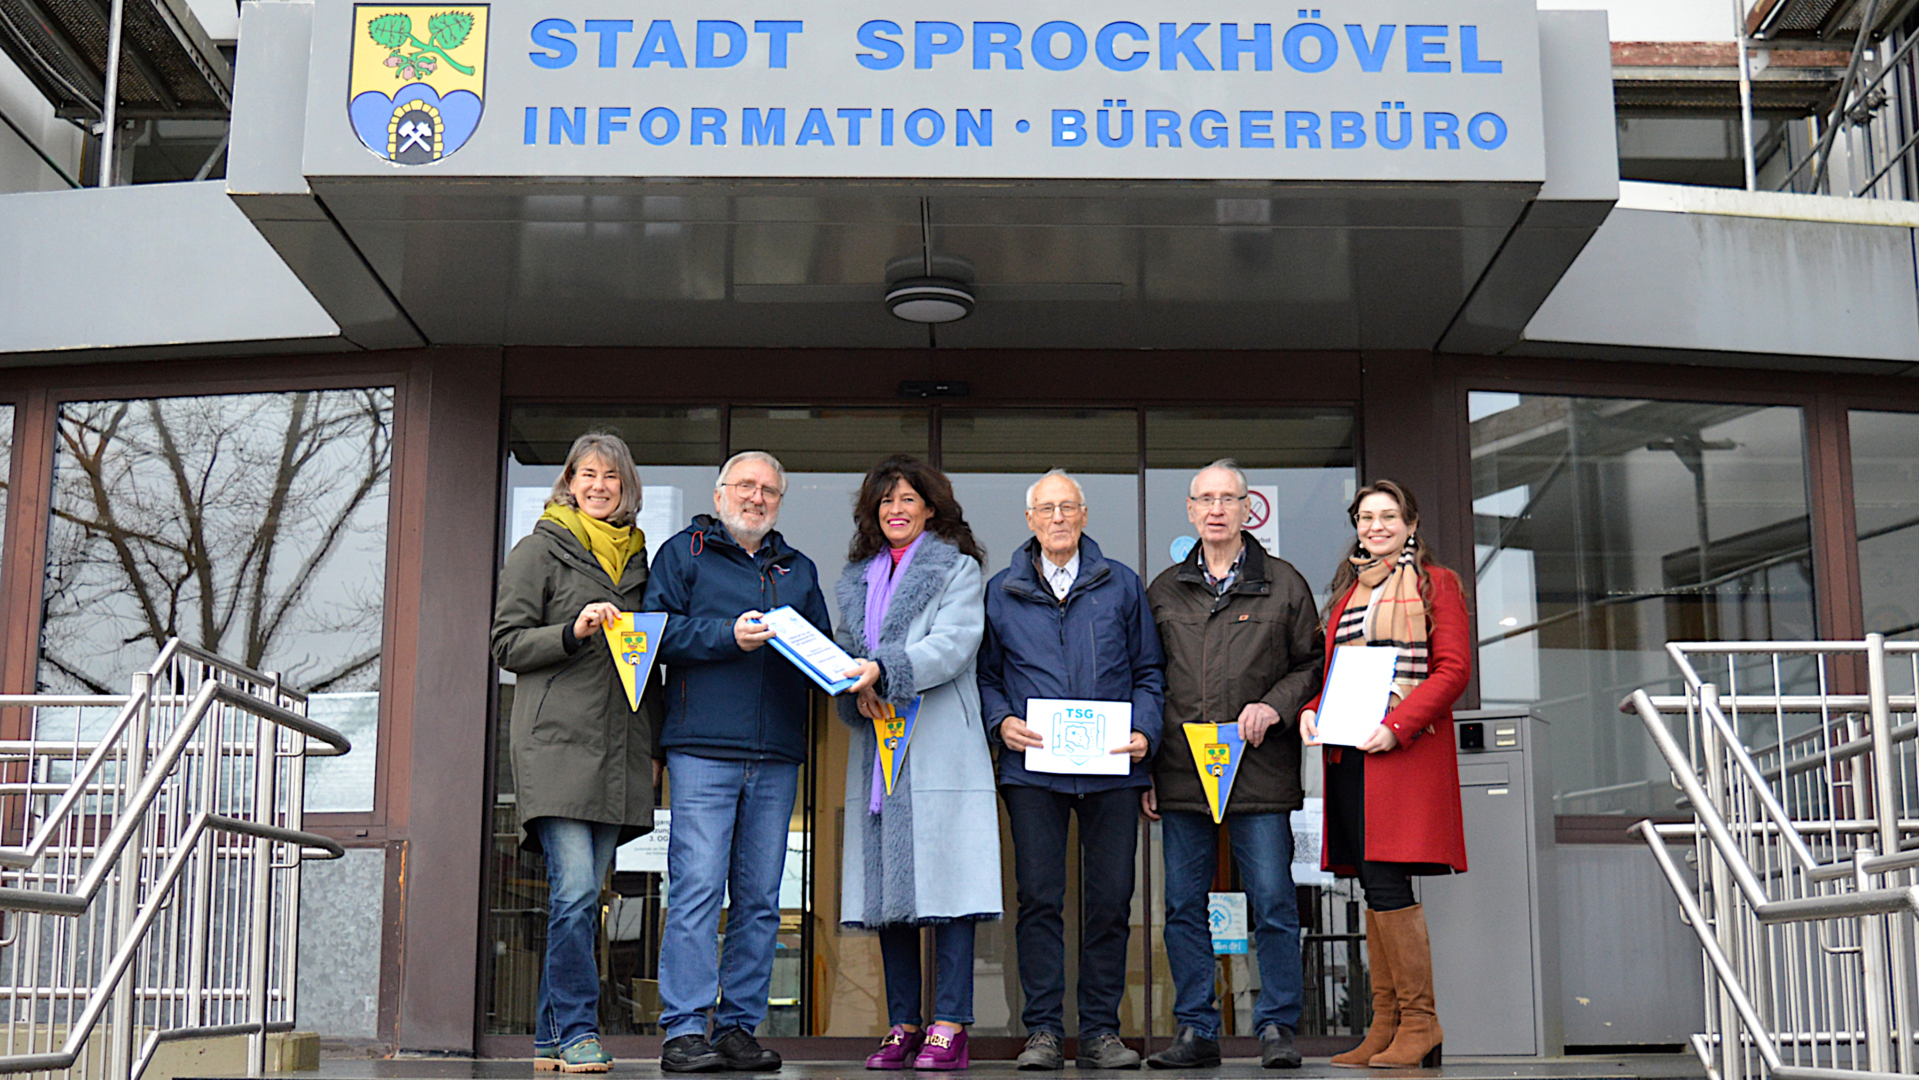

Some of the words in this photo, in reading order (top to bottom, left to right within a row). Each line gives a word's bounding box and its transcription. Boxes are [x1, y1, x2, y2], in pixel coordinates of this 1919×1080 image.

[528, 18, 804, 70] STADT
[856, 9, 1504, 75] SPROCKHÖVEL
[523, 106, 993, 148] INFORMATION
[1051, 99, 1509, 151] BÜRGERBÜRO
[1065, 708, 1094, 719] TSG
